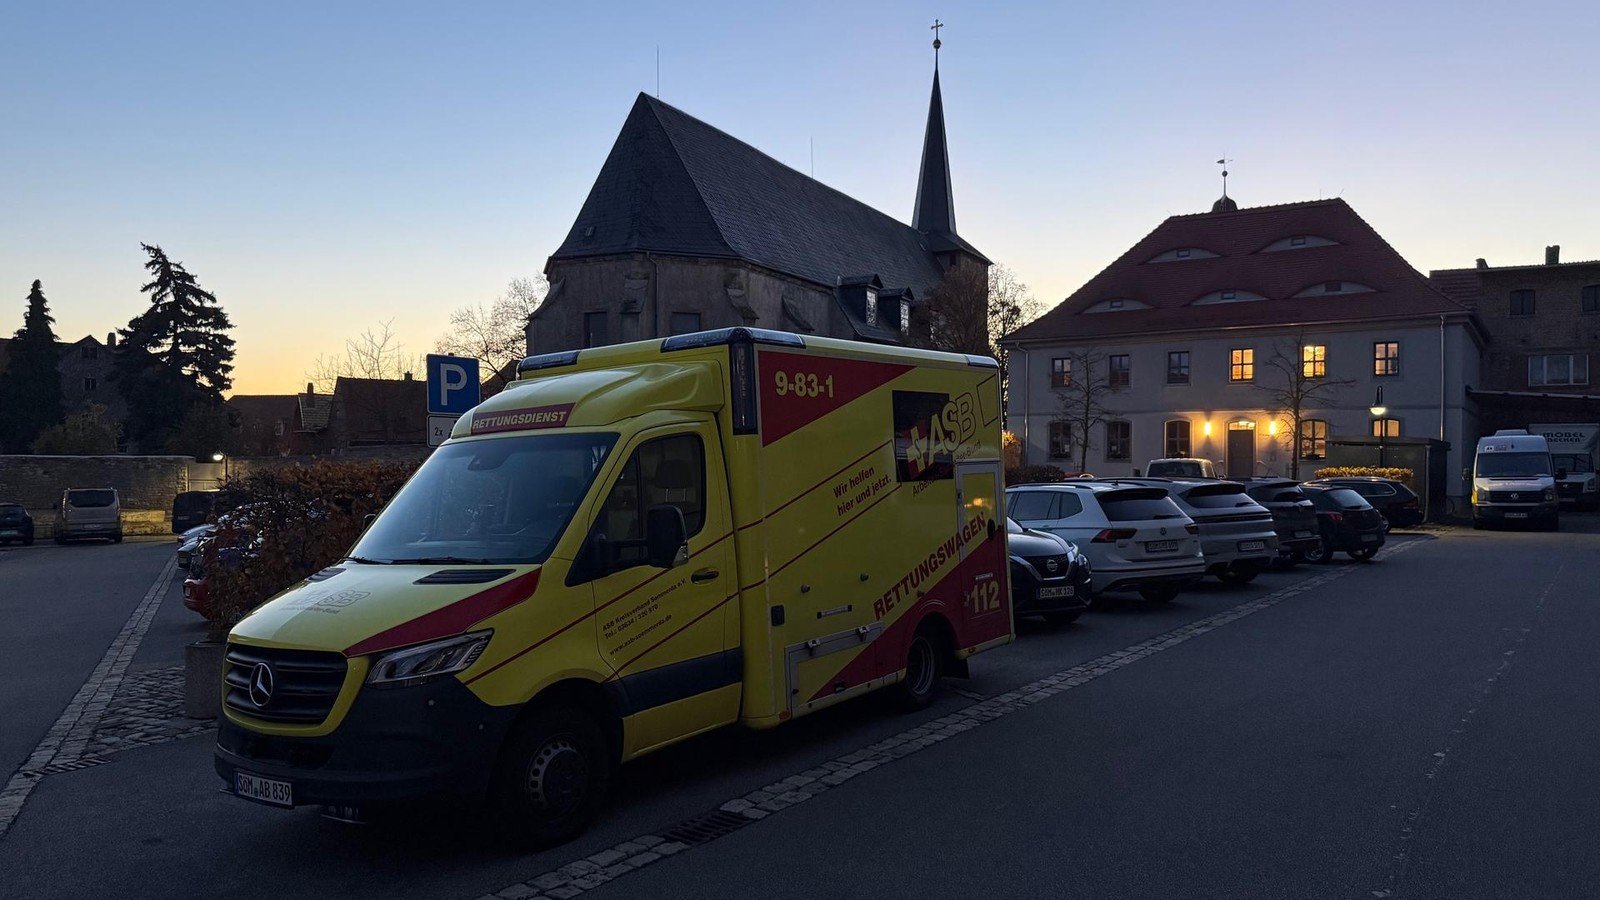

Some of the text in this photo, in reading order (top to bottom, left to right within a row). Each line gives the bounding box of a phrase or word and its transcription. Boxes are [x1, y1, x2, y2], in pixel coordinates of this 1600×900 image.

[440, 363, 468, 406] P
[774, 369, 834, 398] 9-83-1
[472, 411, 567, 430] RETTUNGSDIENST
[928, 391, 976, 467] ASB
[833, 466, 875, 498] Wir helfen
[837, 474, 892, 516] hier und jetzt.
[873, 511, 986, 620] RETTUNGSWAGEN
[970, 580, 1000, 614] 112
[602, 621, 615, 631] ASB
[259, 780, 271, 798] AB
[272, 782, 291, 801] 839
